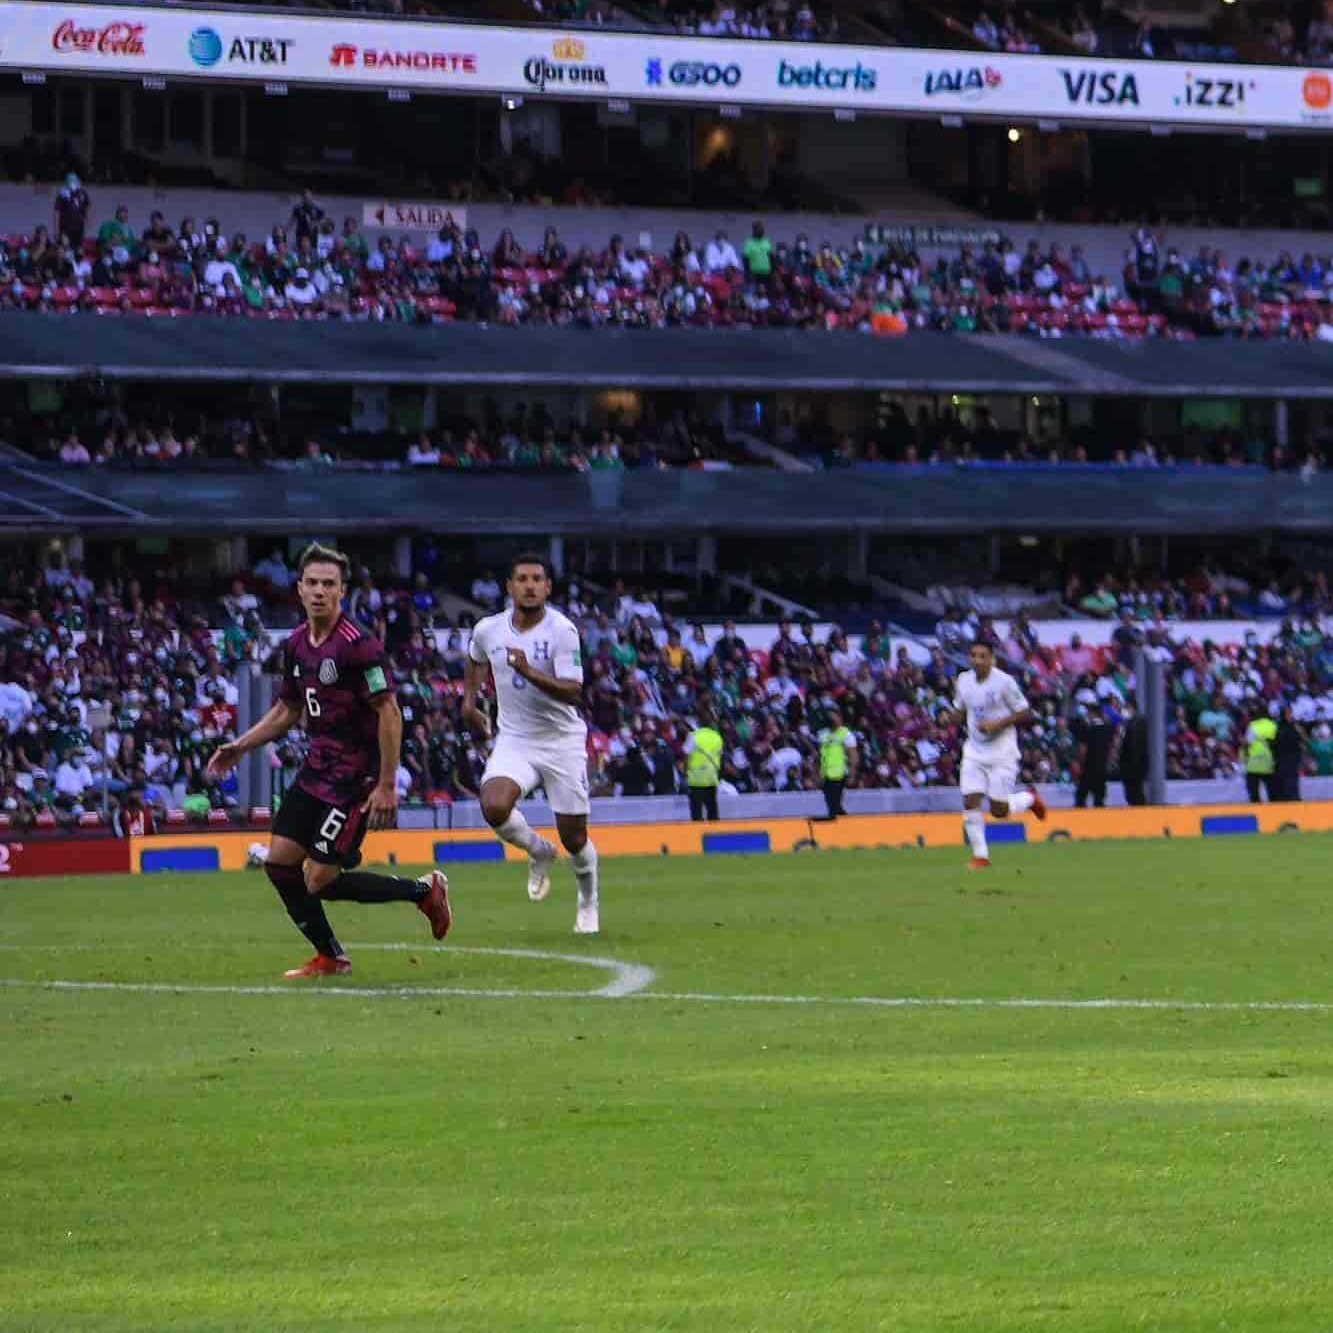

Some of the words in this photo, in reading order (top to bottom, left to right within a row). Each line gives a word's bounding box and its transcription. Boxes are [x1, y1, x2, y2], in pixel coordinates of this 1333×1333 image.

[228, 39, 292, 63] AT&T
[363, 50, 477, 73] BANORTE
[523, 57, 607, 91] Corona
[777, 58, 877, 92] betcris
[1063, 70, 1141, 106] VISA
[534, 641, 549, 660] H
[306, 687, 321, 718] 6
[319, 808, 346, 841] 6
